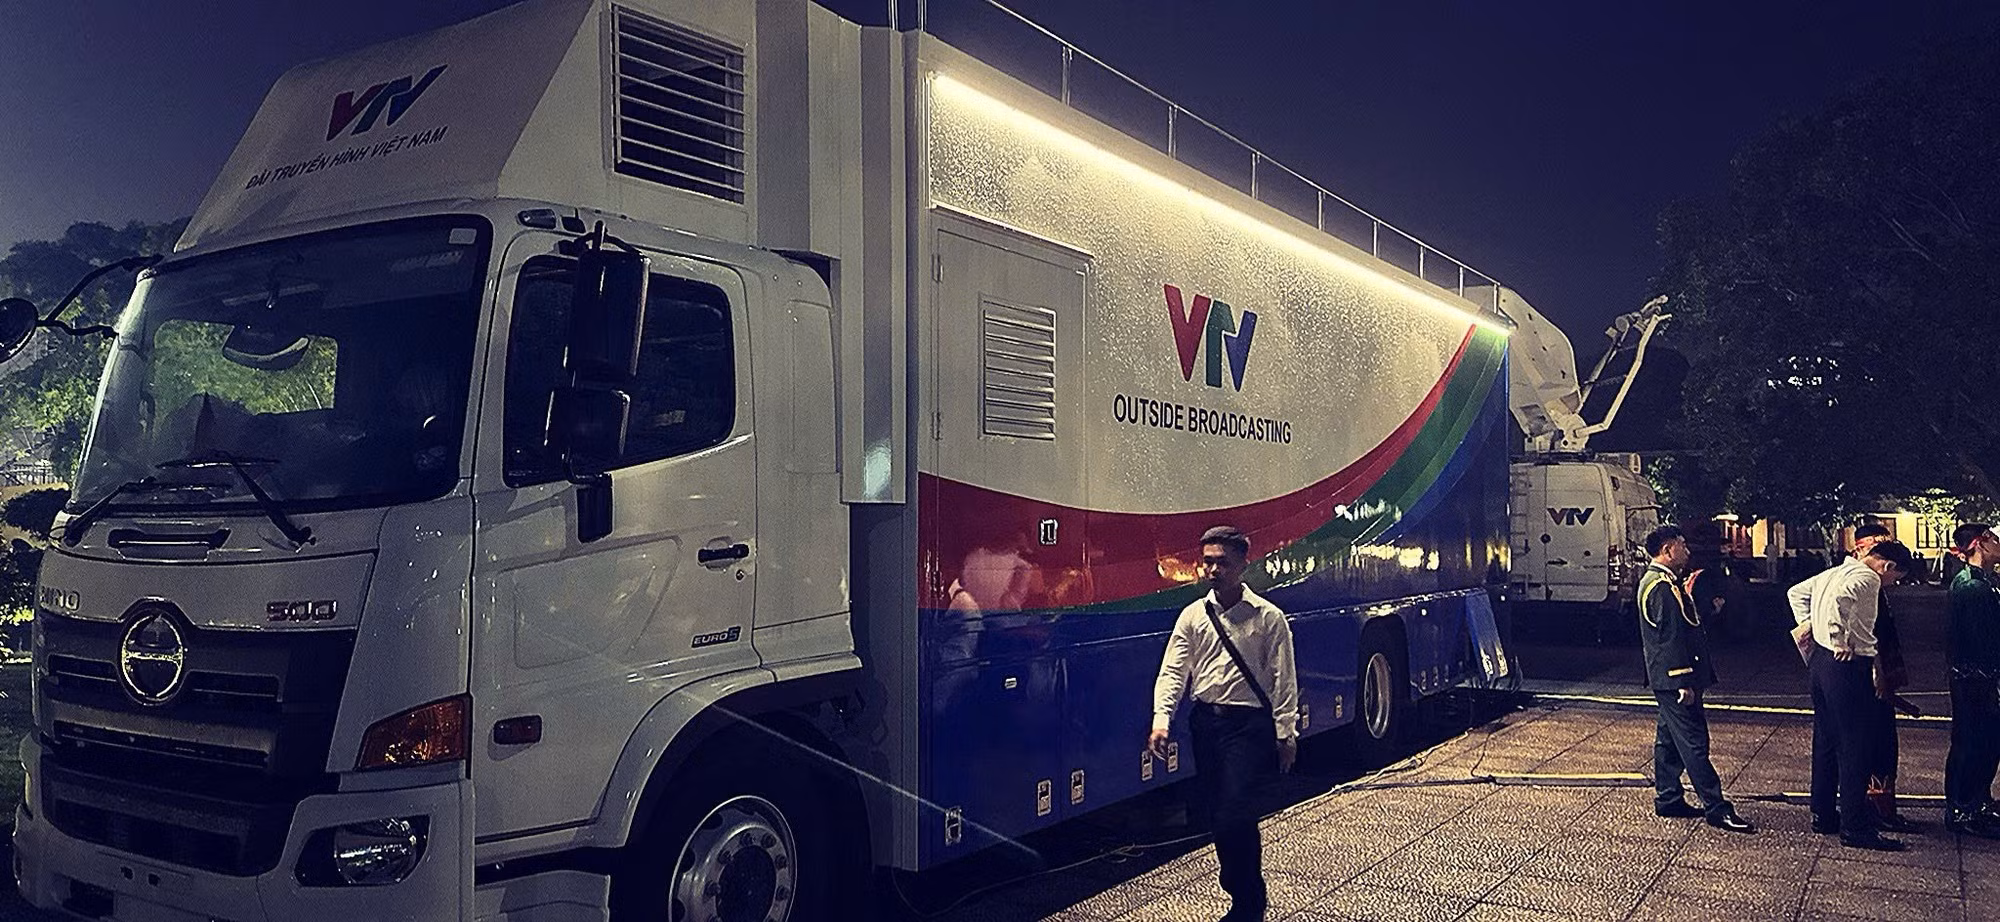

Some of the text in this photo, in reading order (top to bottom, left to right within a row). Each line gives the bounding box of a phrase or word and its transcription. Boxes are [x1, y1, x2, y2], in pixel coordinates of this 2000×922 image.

[326, 64, 448, 141] VTV
[370, 135, 409, 158] VIỆT
[407, 125, 448, 149] NAM
[1164, 283, 1258, 392] VTV
[1113, 394, 1292, 444] OUTSIDE BROADCASTING
[1547, 508, 1595, 526] VTV
[266, 600, 338, 622] 500
